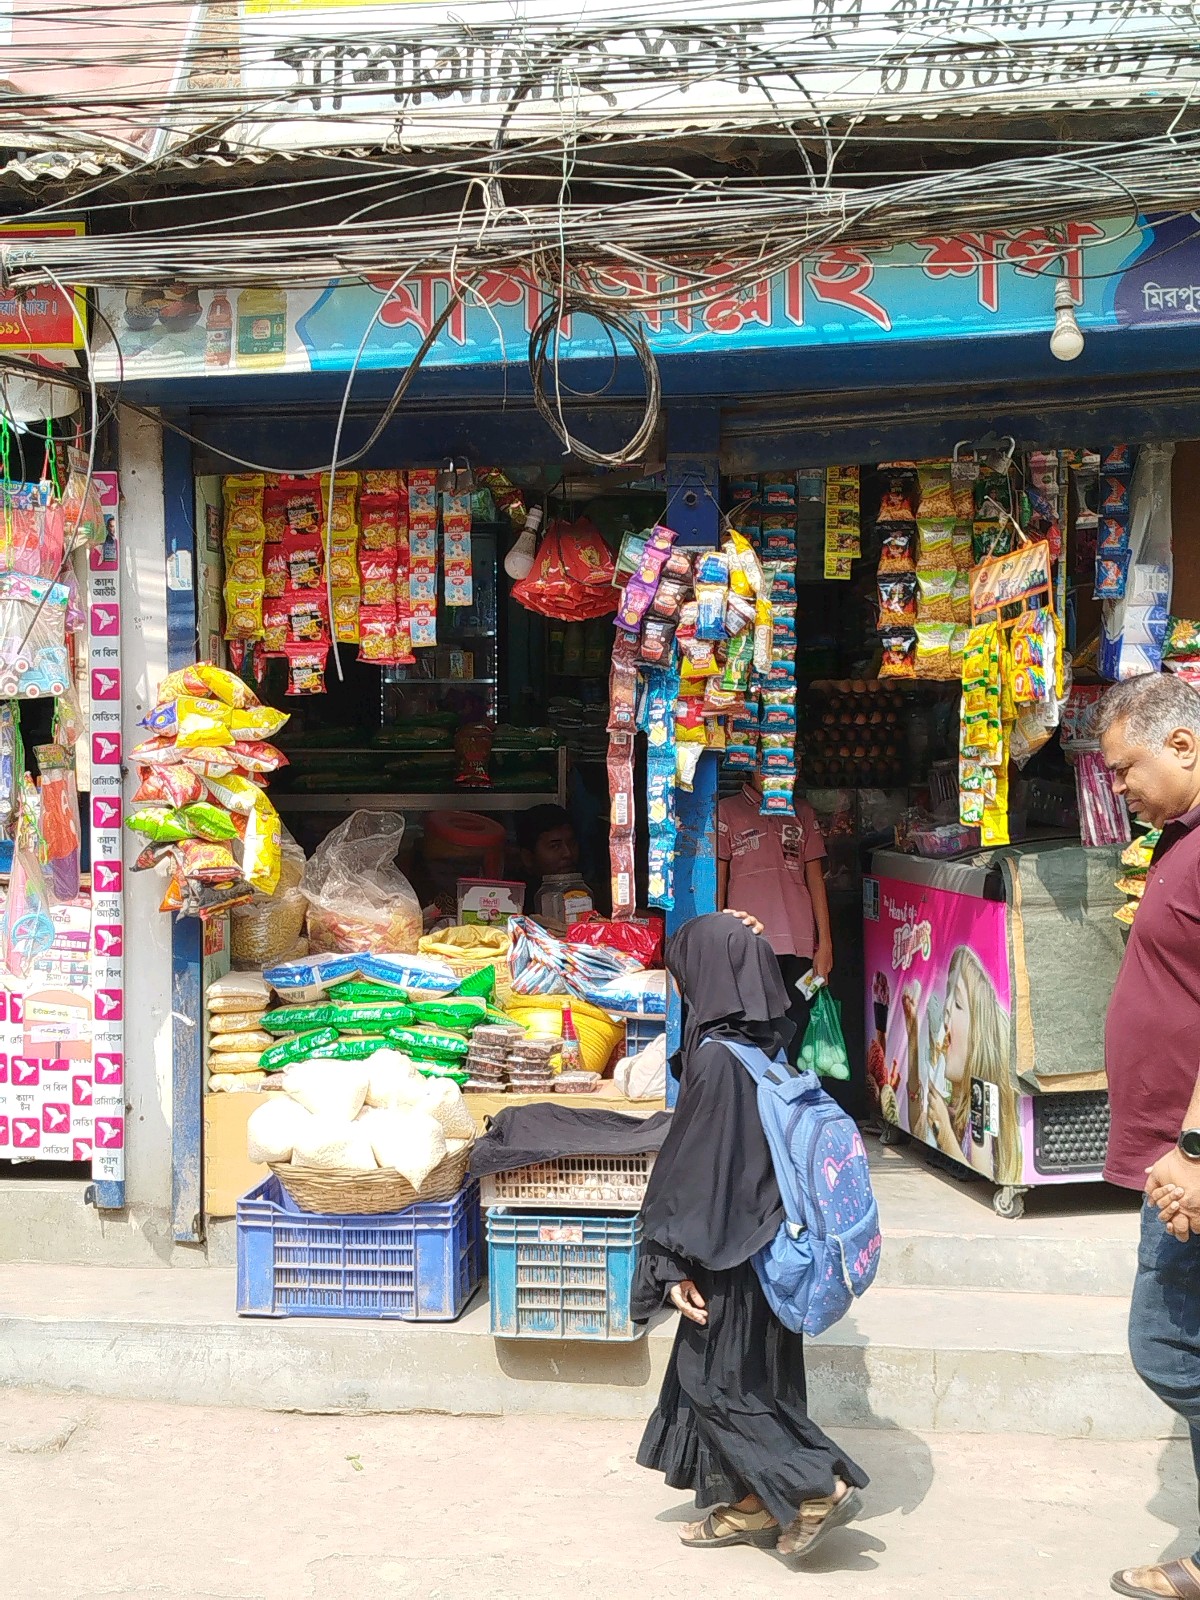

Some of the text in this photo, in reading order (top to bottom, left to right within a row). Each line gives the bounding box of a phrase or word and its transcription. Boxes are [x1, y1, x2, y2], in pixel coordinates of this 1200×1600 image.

[909, 221, 1106, 313] শপ
[94, 578, 114, 587] ক্যাশ
[92, 586, 116, 597] আউট
[92, 646, 118, 657] পে বিল
[92, 711, 120, 721] সেভিংস
[97, 836, 116, 845] ক্যাশ
[102, 845, 112, 854] ইন
[98, 900, 118, 908] ক্যাশ
[96, 908, 120, 918] আউট
[889, 898, 907, 922] Heart
[95, 967, 122, 978] পে বিল
[95, 1031, 122, 1041] সেভিংস
[53, 1082, 68, 1092] বিল
[15, 1093, 34, 1102] ক্যাশ
[20, 1103, 31, 1111] ইন
[42, 1145, 70, 1155] সেভিংস
[98, 1156, 118, 1165] ক্যাশ
[103, 1165, 114, 1174] ইন
